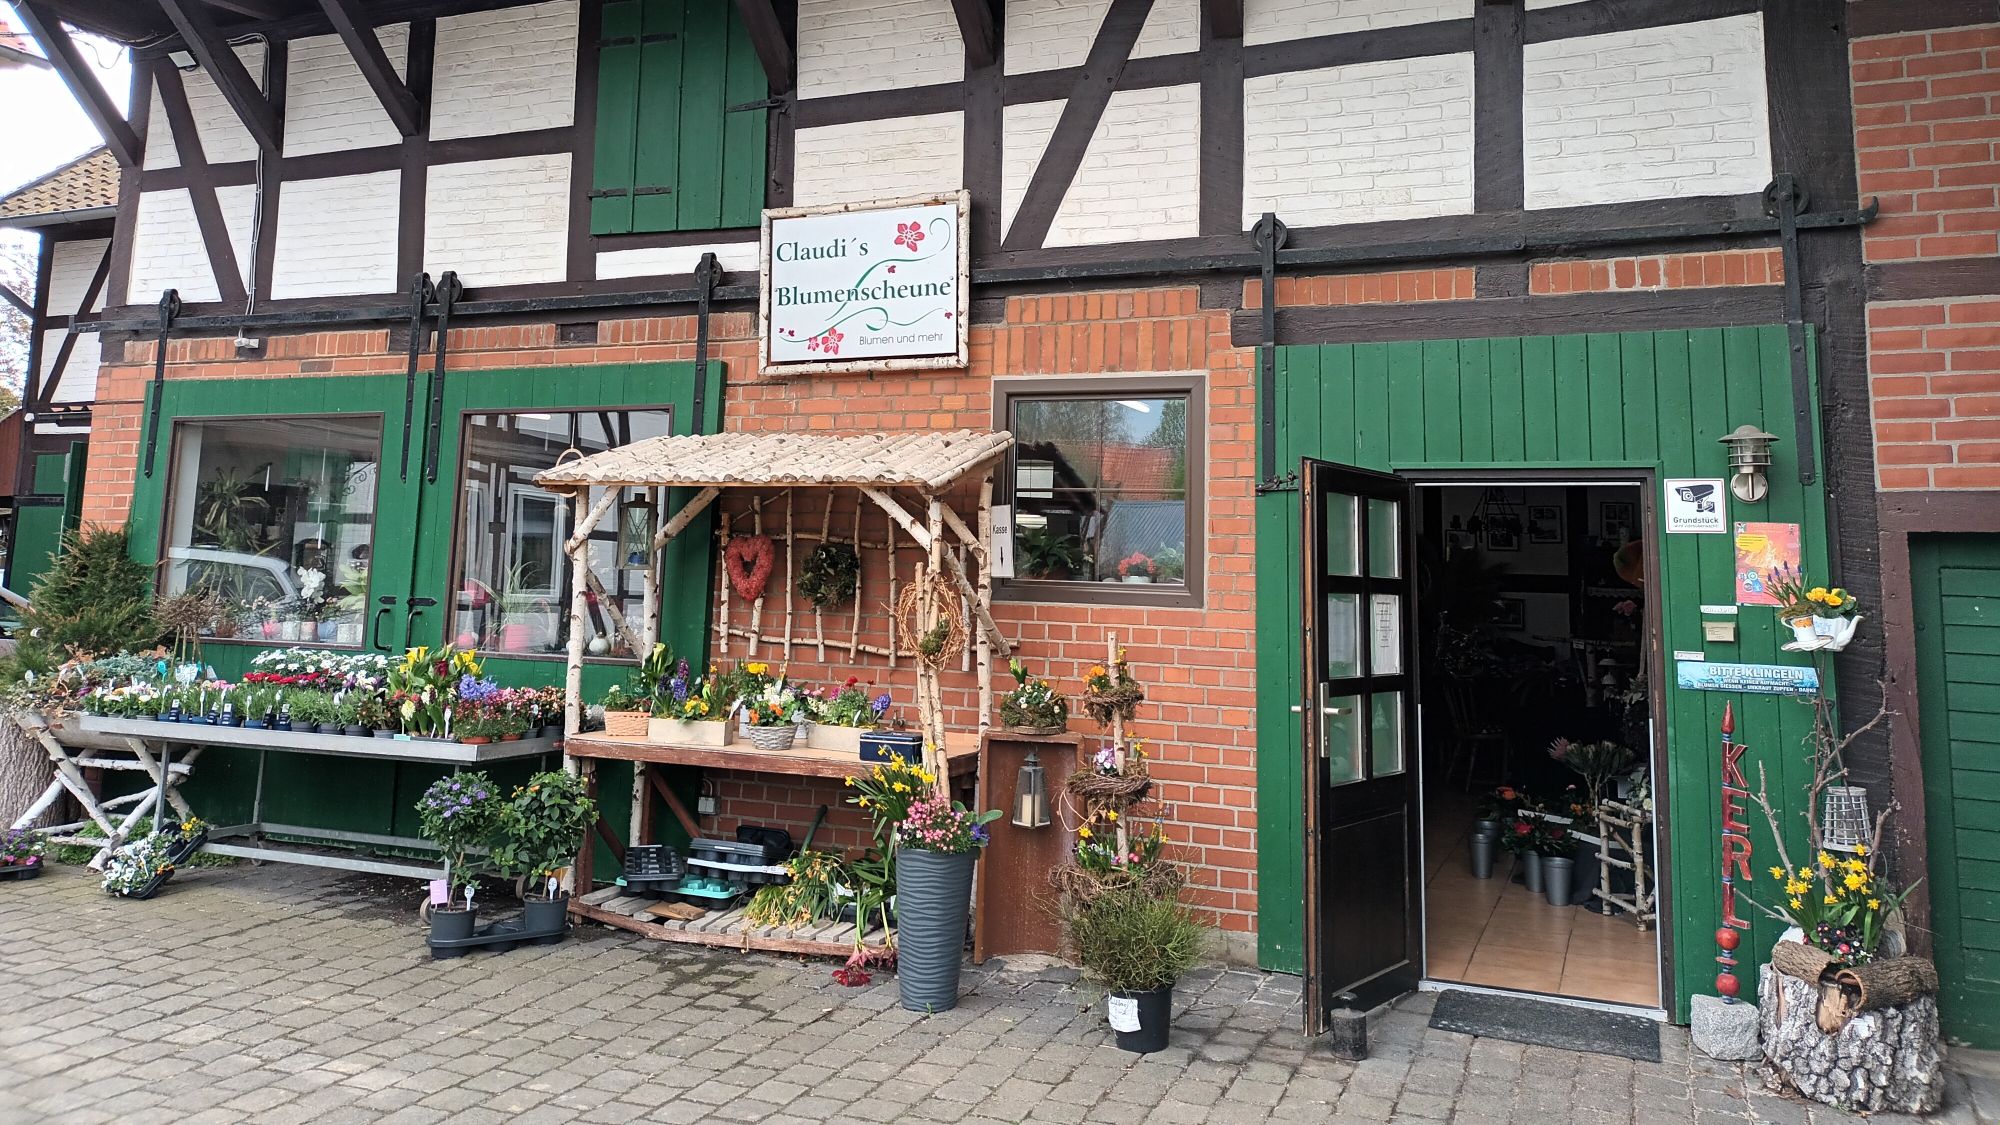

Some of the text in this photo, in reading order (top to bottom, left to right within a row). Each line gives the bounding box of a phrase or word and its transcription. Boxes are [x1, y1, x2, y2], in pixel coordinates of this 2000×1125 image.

[859, 332, 944, 346] Blumen und mehr
[993, 524, 1007, 534] Kasse
[1709, 666, 1803, 679] BITTE KLINGELN
[1721, 741, 1753, 930] KERL
